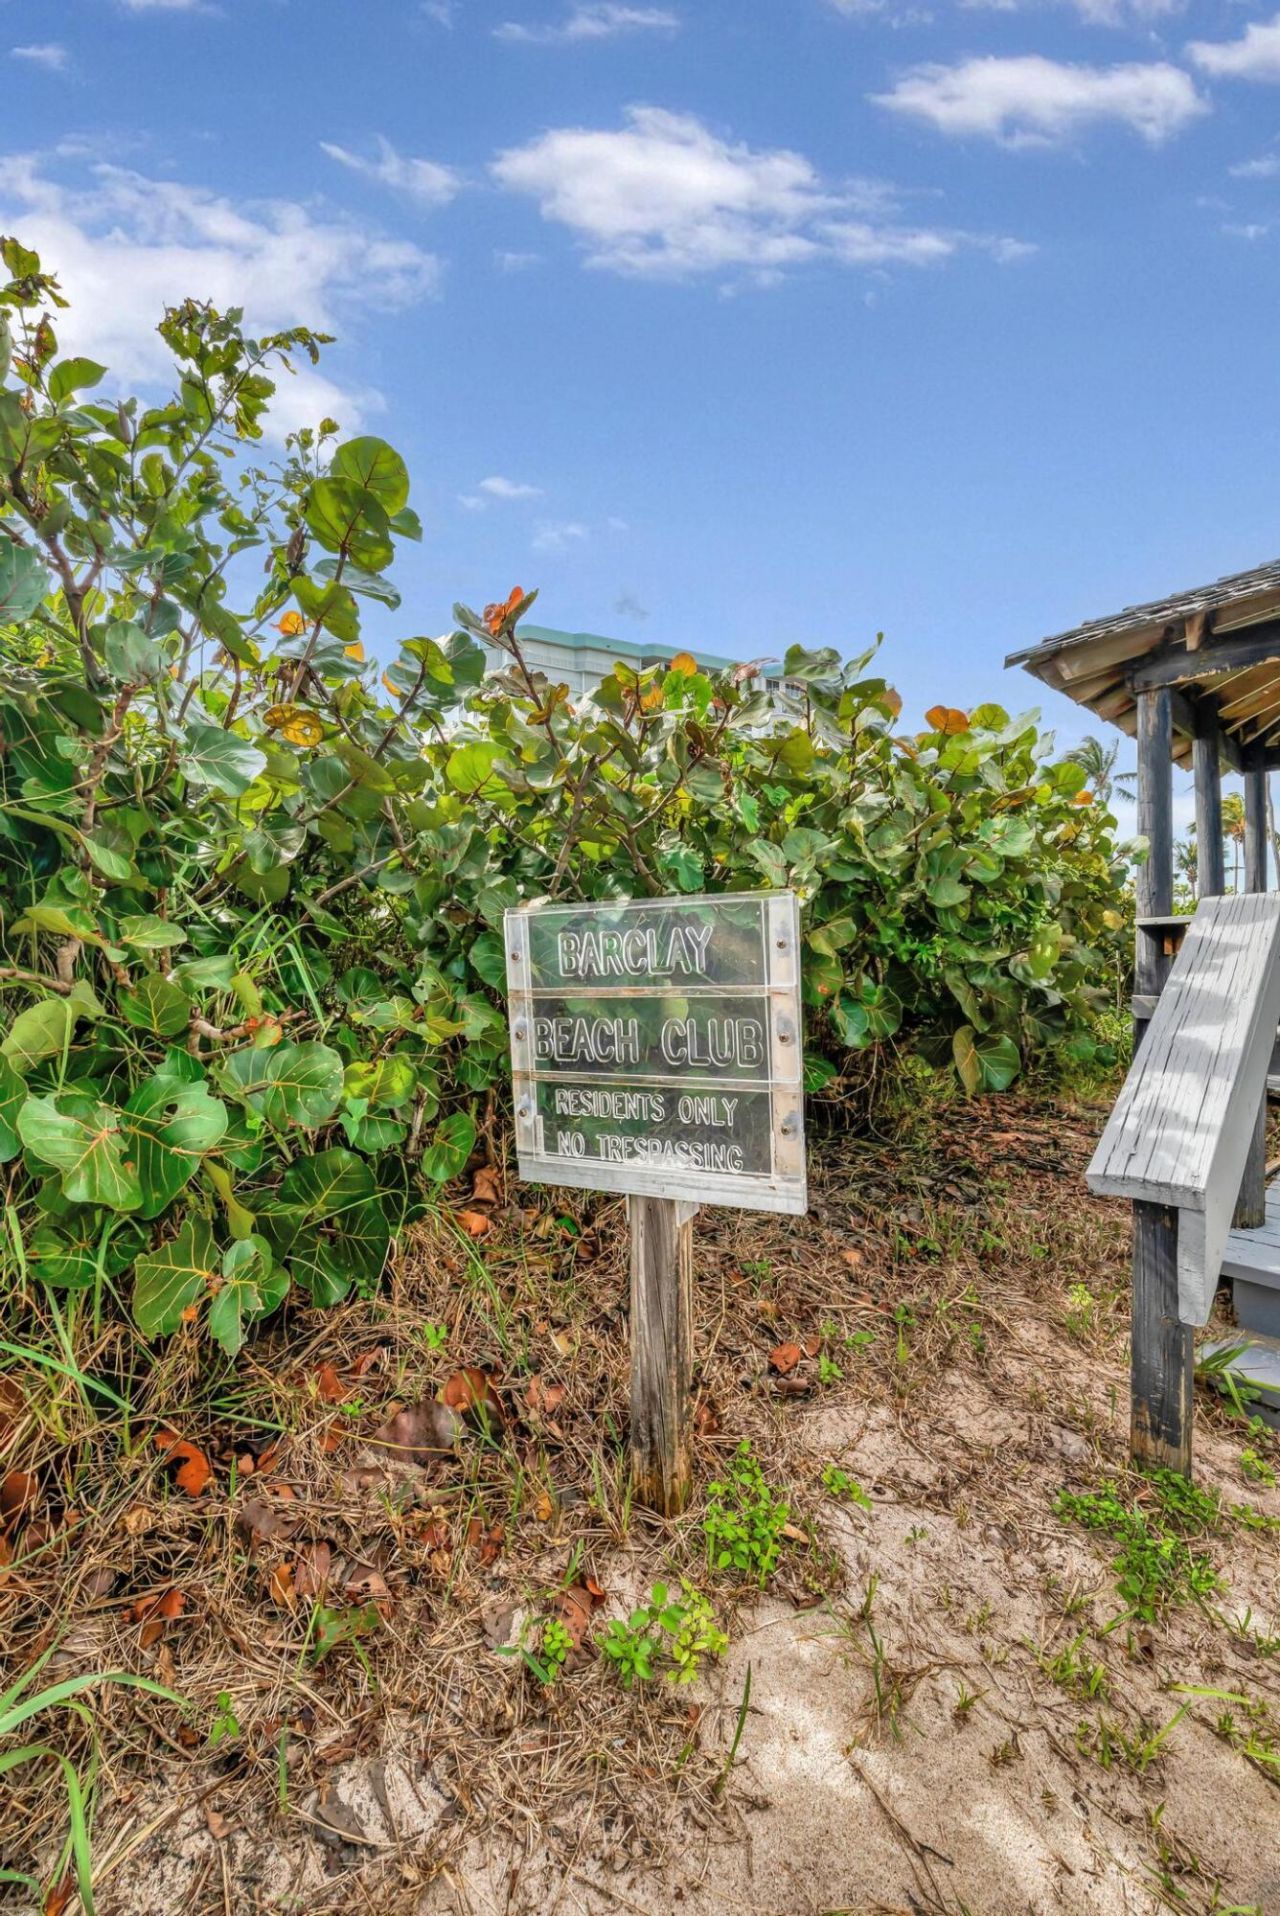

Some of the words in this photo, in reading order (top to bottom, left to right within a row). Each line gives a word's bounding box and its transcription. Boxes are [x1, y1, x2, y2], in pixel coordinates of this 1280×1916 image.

[558, 926, 713, 977] BARCLAY
[533, 1017, 639, 1063] BEACH
[661, 1018, 764, 1068] CLUB
[555, 1088, 665, 1122] RESIDENTS
[678, 1095, 738, 1127] ONLY
[557, 1131, 585, 1158] NO
[596, 1134, 744, 1174] TRESPASSING
